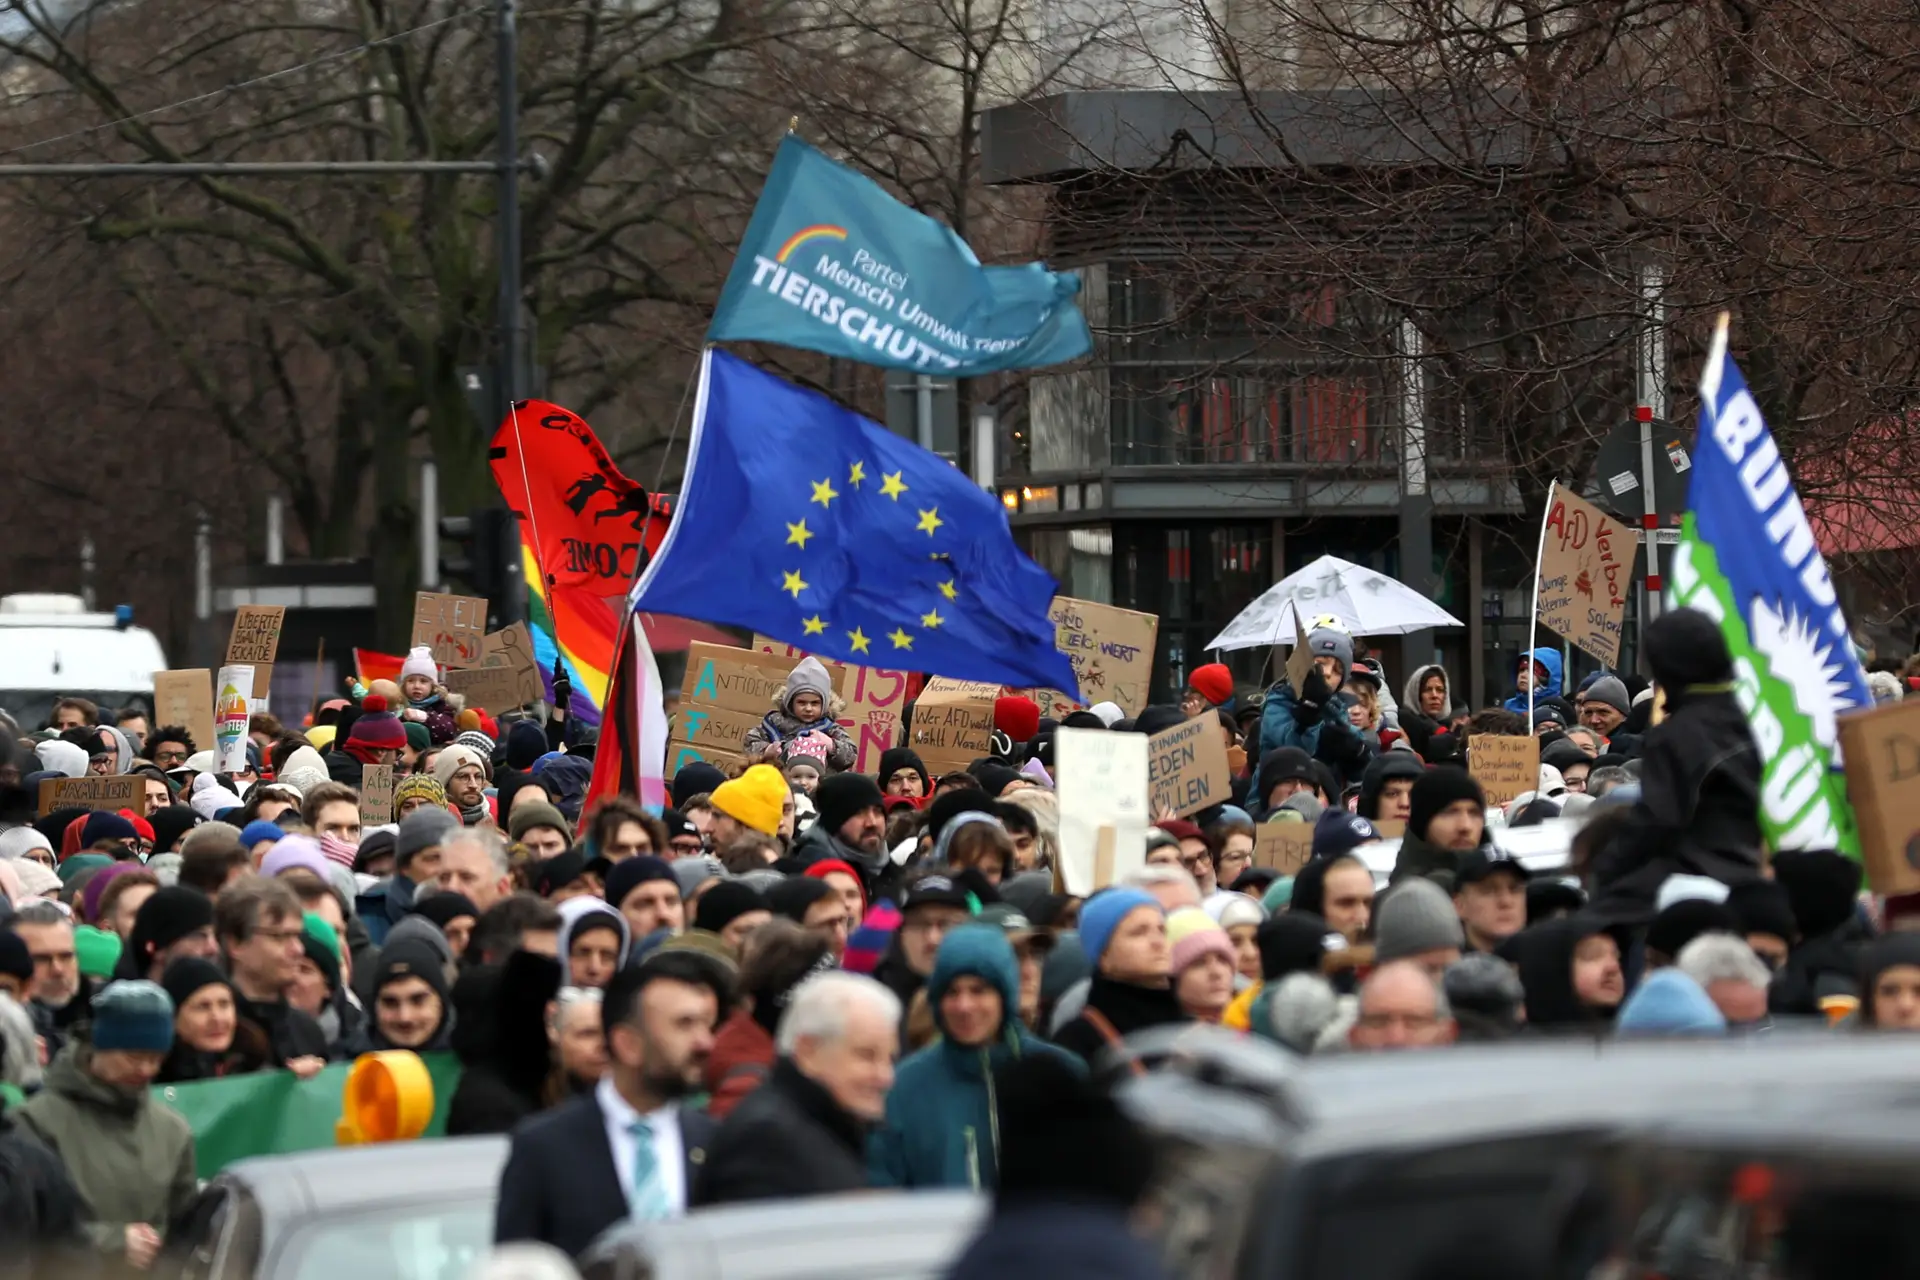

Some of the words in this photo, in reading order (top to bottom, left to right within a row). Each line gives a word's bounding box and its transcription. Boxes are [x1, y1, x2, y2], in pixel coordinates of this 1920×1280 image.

[852, 249, 908, 291] Partei
[815, 254, 895, 311] Mensch
[899, 299, 969, 350] Umwelt
[1546, 500, 1588, 552] AfD
[1595, 517, 1625, 609] Verbot
[1538, 574, 1568, 593] Junge
[238, 610, 282, 630] LIBERTÉ
[1052, 610, 1084, 629] SIND
[1587, 607, 1622, 638] Sofort
[683, 709, 752, 743] FASCHI
[915, 706, 941, 725] Wer
[942, 706, 970, 728] AFD
[1471, 738, 1492, 752] Wer
[1149, 742, 1195, 783] EDEN
[54, 778, 133, 799] FAMILIEN
